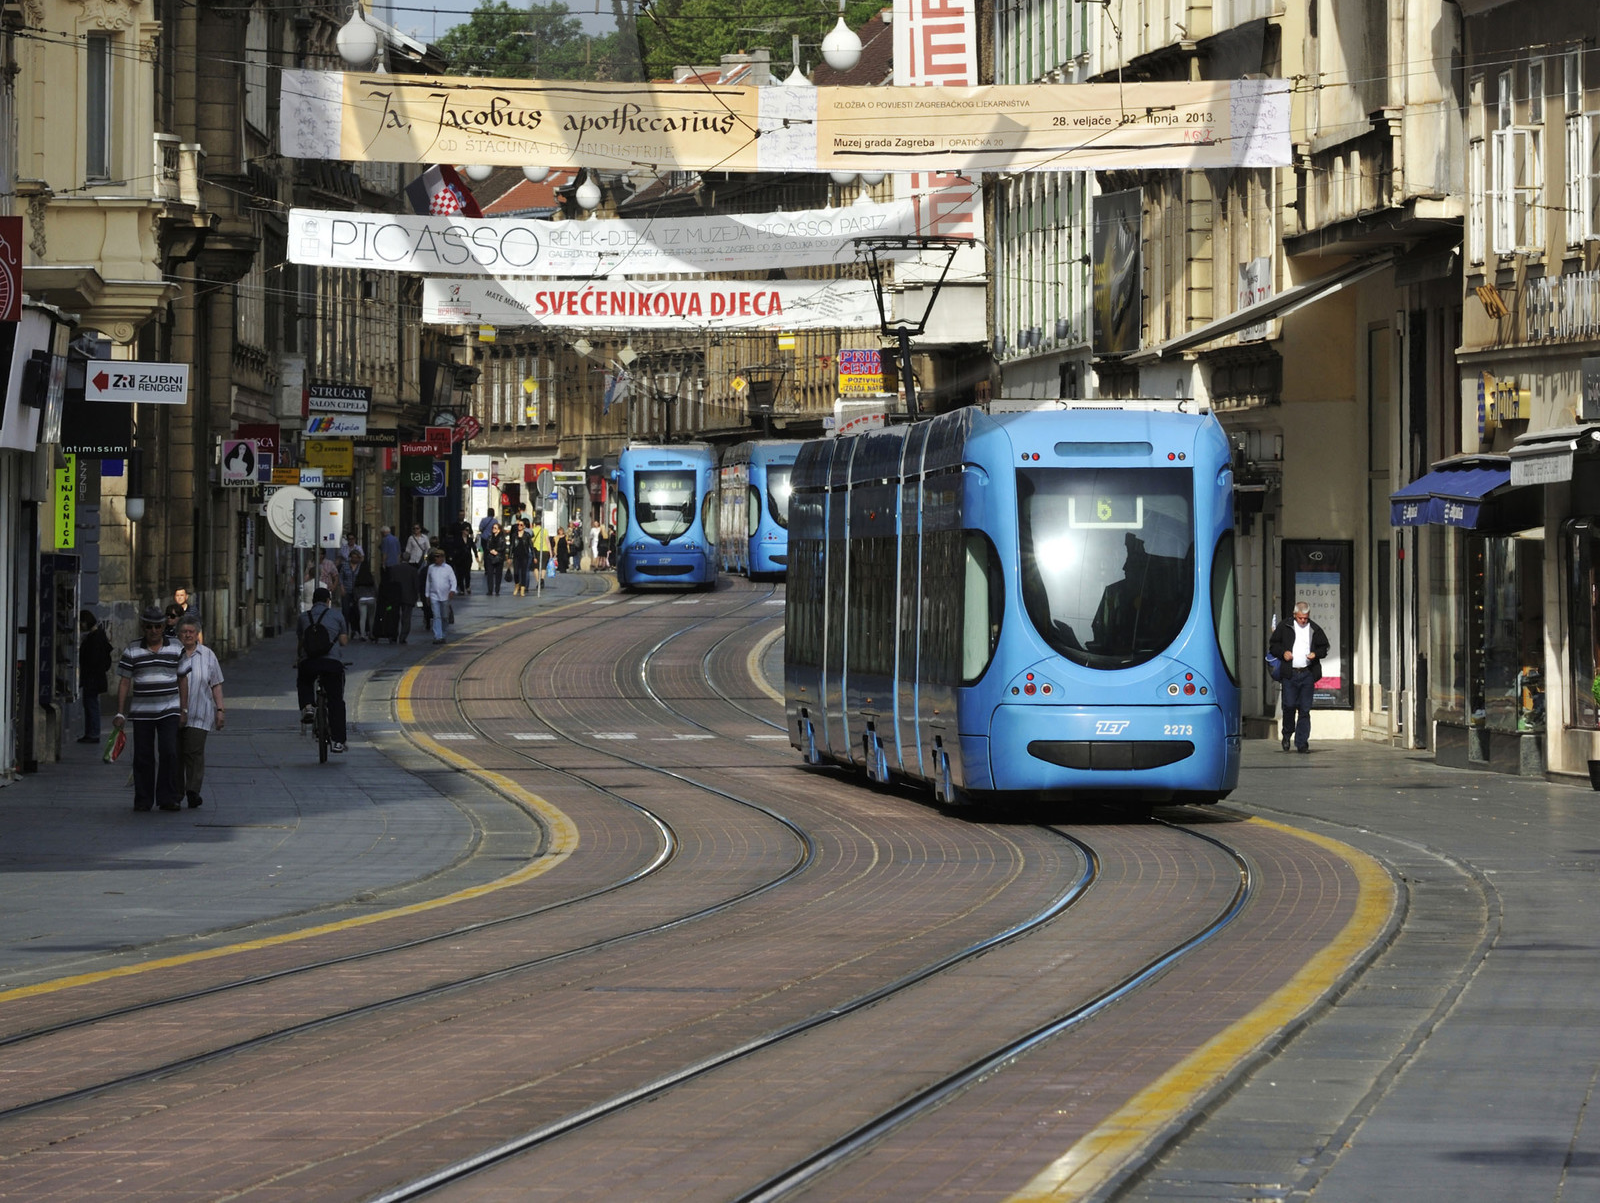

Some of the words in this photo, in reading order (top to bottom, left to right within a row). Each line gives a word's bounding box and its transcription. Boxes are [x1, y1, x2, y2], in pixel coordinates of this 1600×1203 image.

[833, 100, 866, 110] IZLOŽBA
[876, 101, 913, 109] POVIJESTI
[914, 99, 975, 109] ZAGREBAČKOG
[976, 99, 1030, 108] LJEKARNIŠTVA
[1052, 116, 1070, 127] 28.
[1073, 114, 1112, 128] veljače
[1186, 112, 1216, 124] 2013.
[415, 92, 543, 162] Jacobus
[563, 102, 737, 162] apothecarius
[438, 139, 458, 152] OD
[465, 135, 540, 154] ŠTACUNA
[549, 142, 570, 155] DO
[581, 143, 675, 160] INDUSTRIJE
[833, 138, 862, 148] Muzej
[864, 138, 892, 149] grada
[895, 137, 935, 148] Zagreba
[948, 138, 992, 147] OPATIČKA
[549, 230, 657, 246] REMEK-DJELA
[663, 228, 681, 244] IZ
[686, 225, 751, 244] MUZEJA
[839, 214, 889, 233] PARIZ
[331, 219, 540, 267] PICASSO
[485, 289, 504, 303] MATE
[535, 285, 701, 317] SVEĆENIKOVA
[710, 291, 783, 317] DJECA
[840, 350, 881, 362] PRIN
[841, 362, 882, 375] CENT
[139, 375, 183, 384] ZUBNI
[138, 383, 183, 393] RENDGEN
[310, 386, 367, 399] STRUGAR
[309, 399, 335, 408] SALON
[337, 401, 367, 410] CIPELA
[62, 445, 128, 453] intimissimi
[402, 445, 433, 453] Triumph
[410, 471, 431, 484] taja
[1097, 498, 1112, 521] 6
[1096, 720, 1130, 735] ZET
[1163, 725, 1193, 736] 2273
